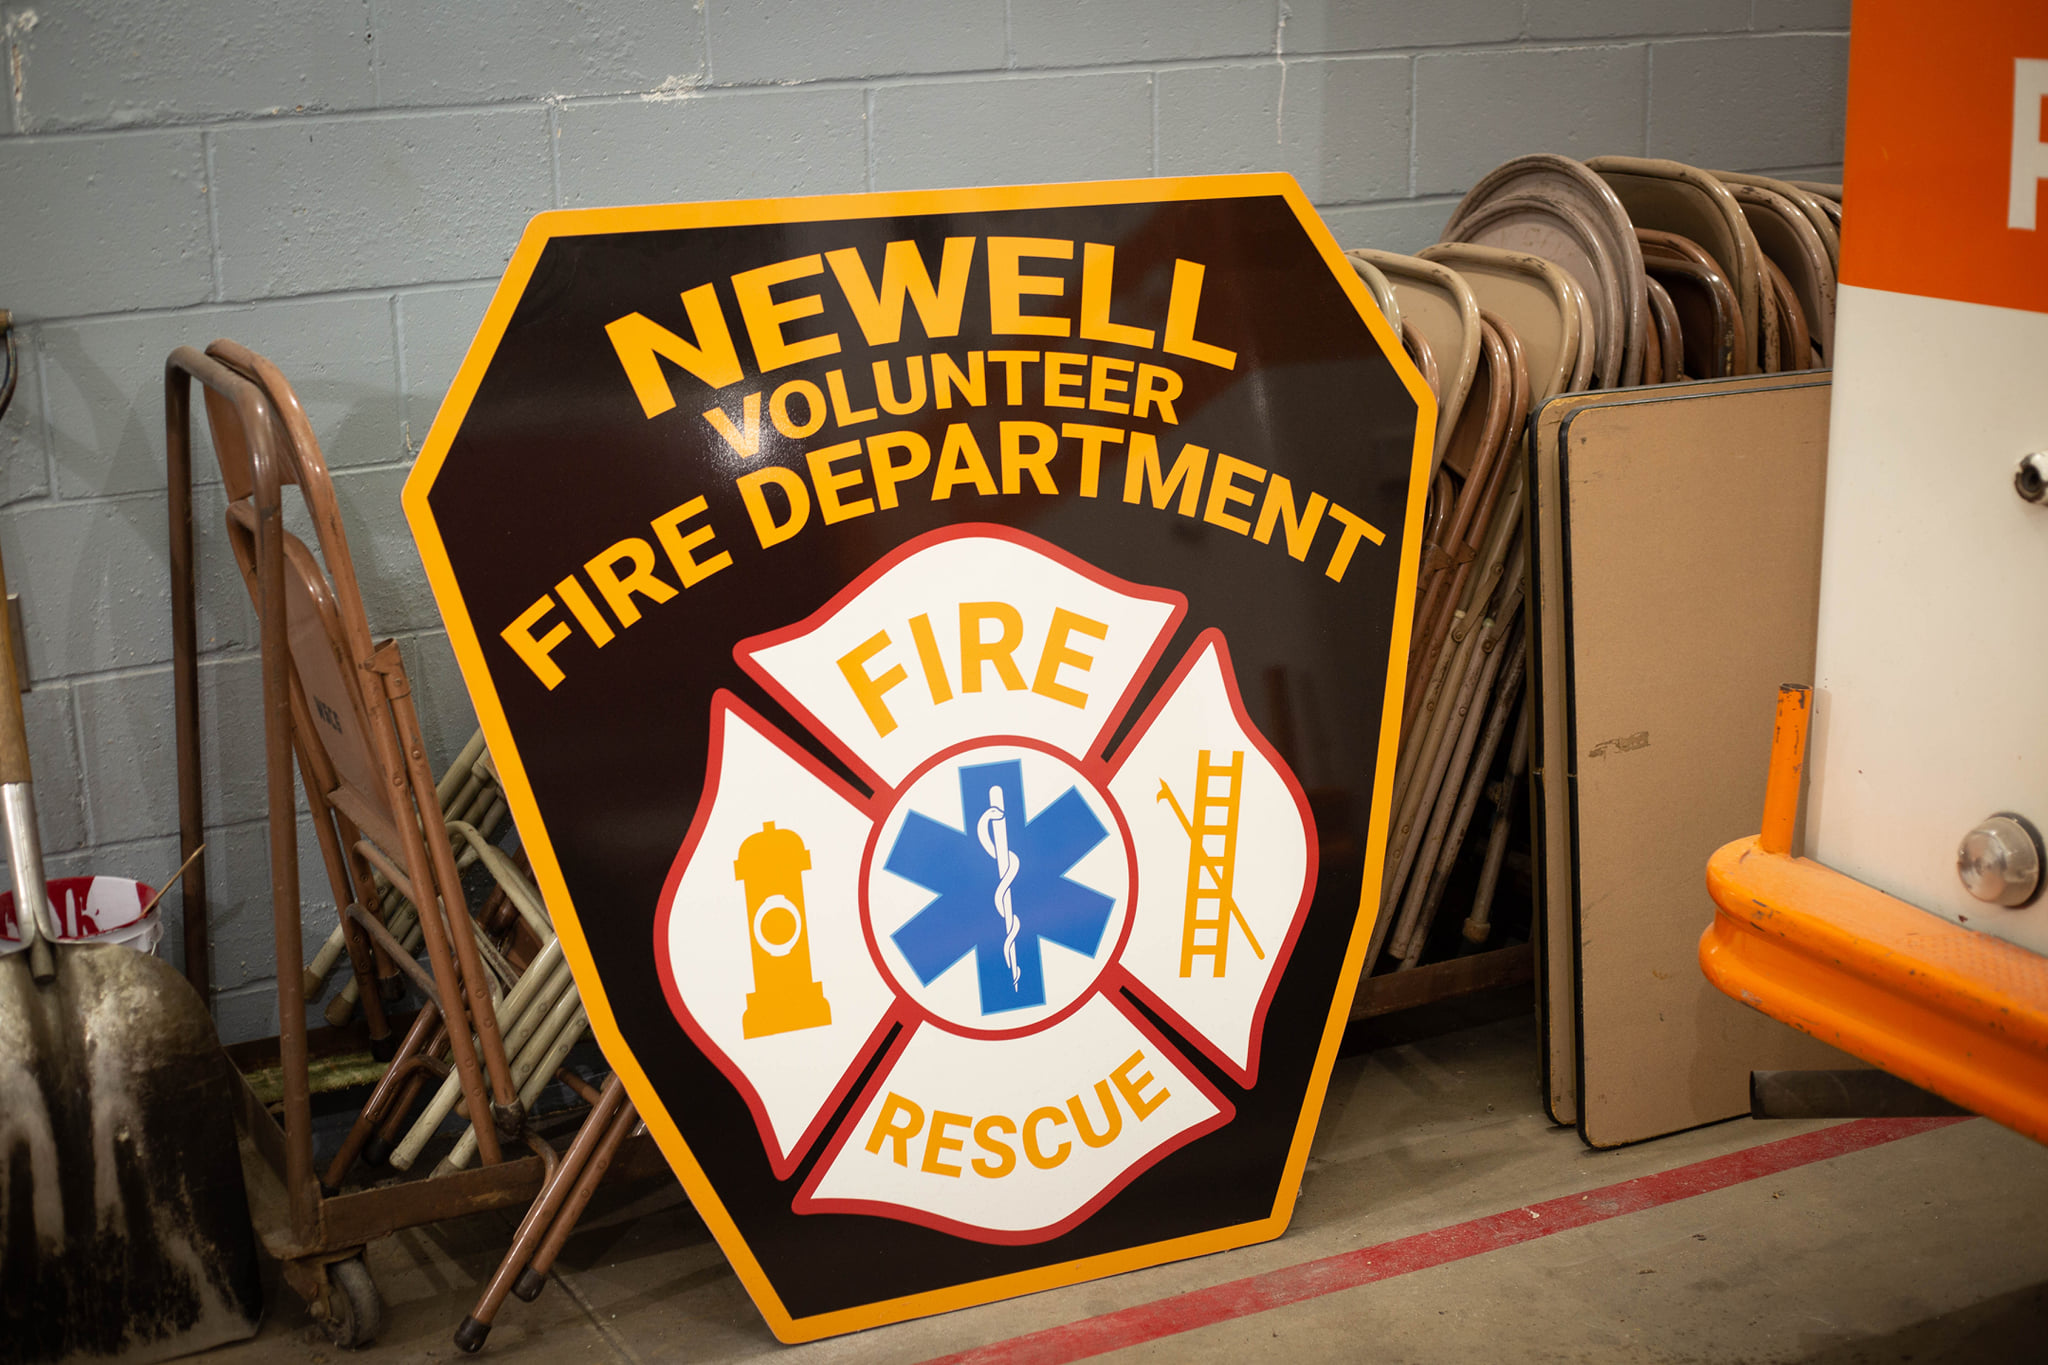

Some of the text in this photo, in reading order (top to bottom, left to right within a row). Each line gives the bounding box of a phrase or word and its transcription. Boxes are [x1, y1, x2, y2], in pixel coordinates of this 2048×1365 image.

[604, 236, 1237, 420] NEWELL
[702, 349, 1184, 460] VOLUNTEER
[500, 419, 1387, 691] FIRE DEPARTMENT
[836, 601, 1109, 739] FIRE
[865, 1049, 1172, 1182] RESCUE
